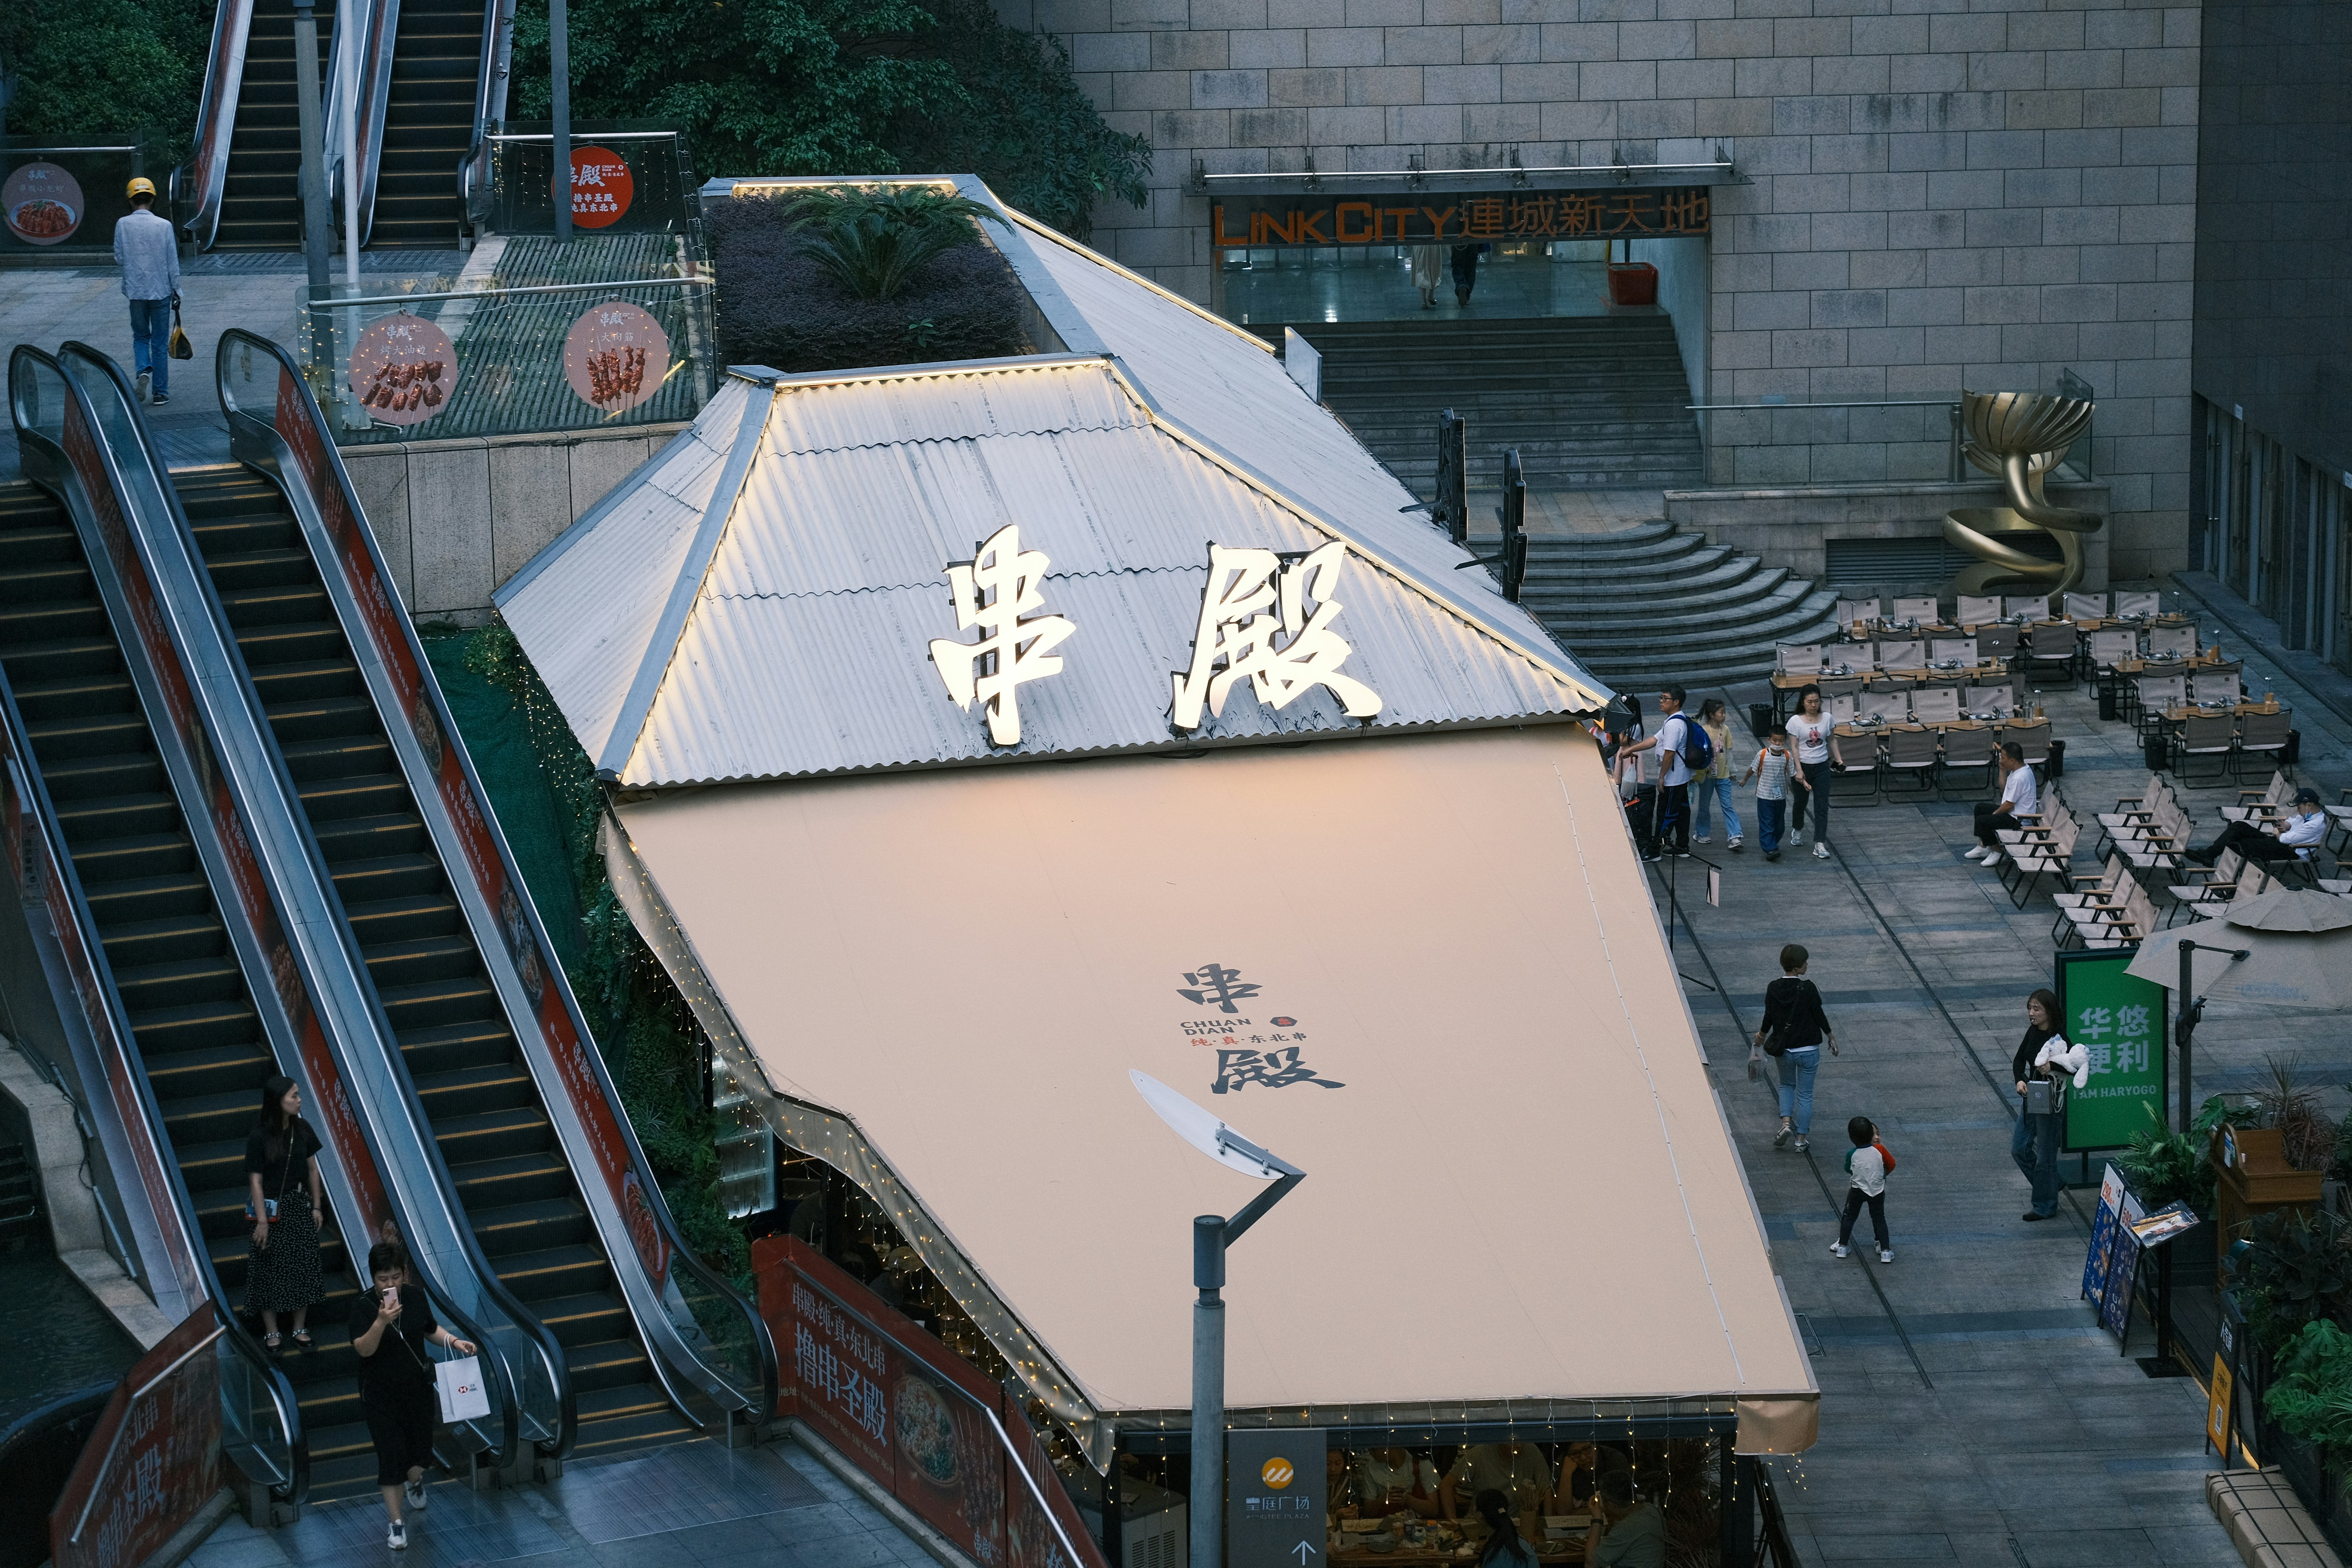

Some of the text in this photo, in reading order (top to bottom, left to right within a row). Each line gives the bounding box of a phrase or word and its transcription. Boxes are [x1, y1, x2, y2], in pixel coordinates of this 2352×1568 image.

[1457, 191, 1710, 239] 連城新天地
[601, 332, 634, 342] 大肉筋
[380, 344, 428, 355] 烤大油边
[927, 523, 1384, 746] 串殿
[1180, 1018, 1252, 1029] CHUAN
[2079, 1004, 2150, 1039] 华悠
[1184, 1026, 1235, 1035] DIAN
[2101, 1084, 2157, 1098] HARYOGO
[794, 1321, 887, 1447] 撸串圣殿
[1246, 1496, 1310, 1511] 皇庭广场
